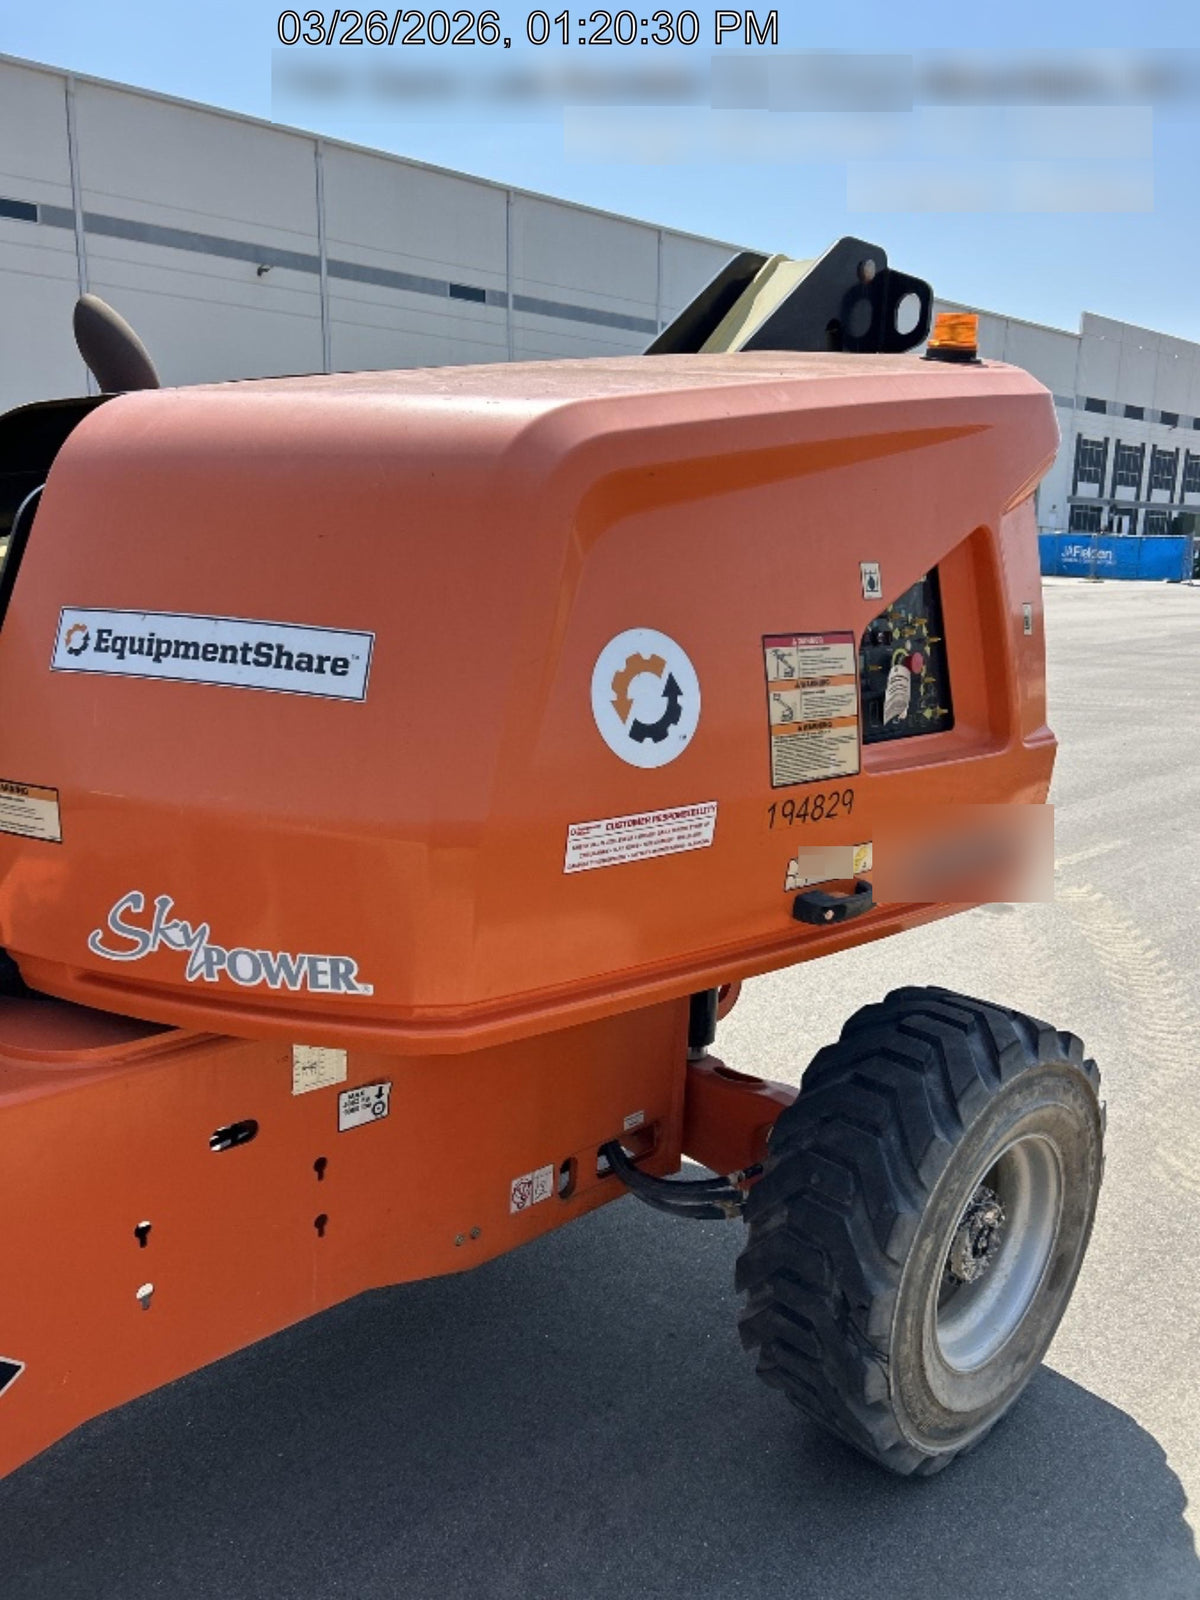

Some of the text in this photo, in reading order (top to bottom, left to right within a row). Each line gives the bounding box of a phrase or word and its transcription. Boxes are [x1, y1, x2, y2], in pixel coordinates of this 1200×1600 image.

[93, 628, 351, 677] EquipmentShare
[605, 814, 651, 831] CUSTOMER
[767, 788, 855, 829] 194829
